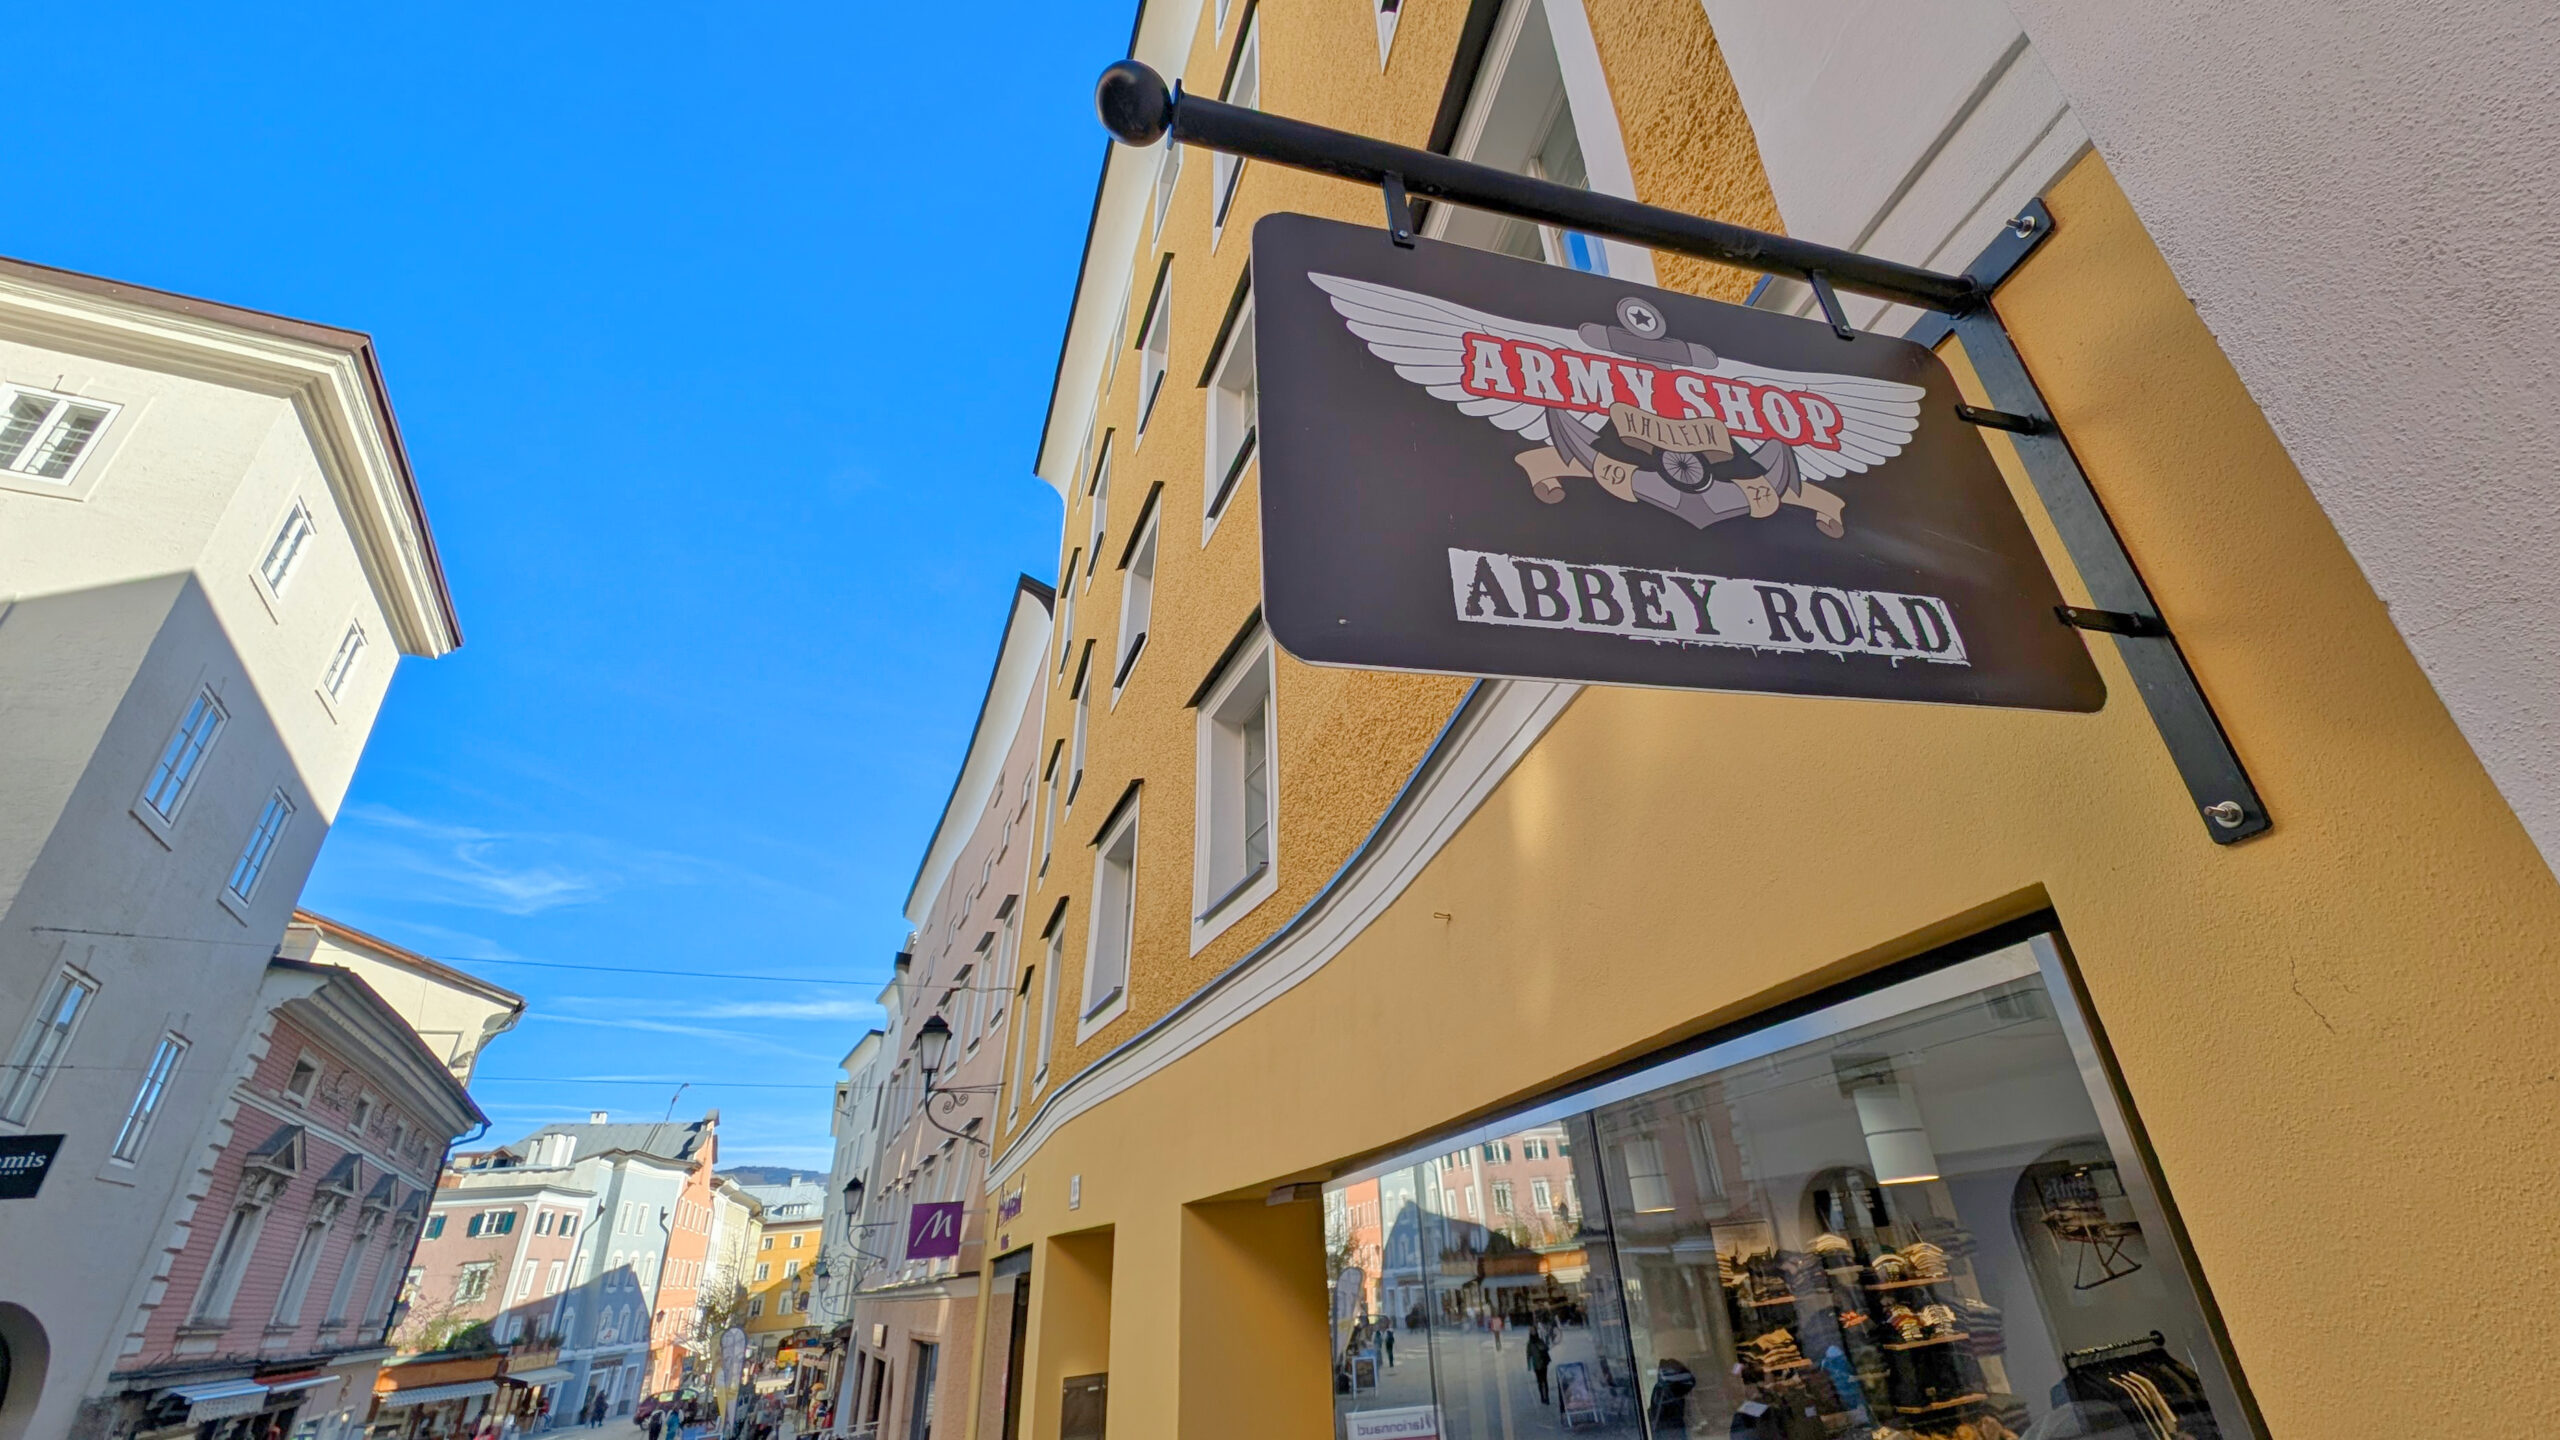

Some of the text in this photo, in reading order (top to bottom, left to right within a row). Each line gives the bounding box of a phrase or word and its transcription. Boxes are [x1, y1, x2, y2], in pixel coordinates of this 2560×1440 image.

[1470, 337, 1839, 446] ARMY SHOP
[1624, 411, 1719, 447] HALLEIN
[1600, 463, 1772, 509] 19 77
[1464, 555, 1953, 655] ABBEY ROAD
[0, 1151, 47, 1169] mis
